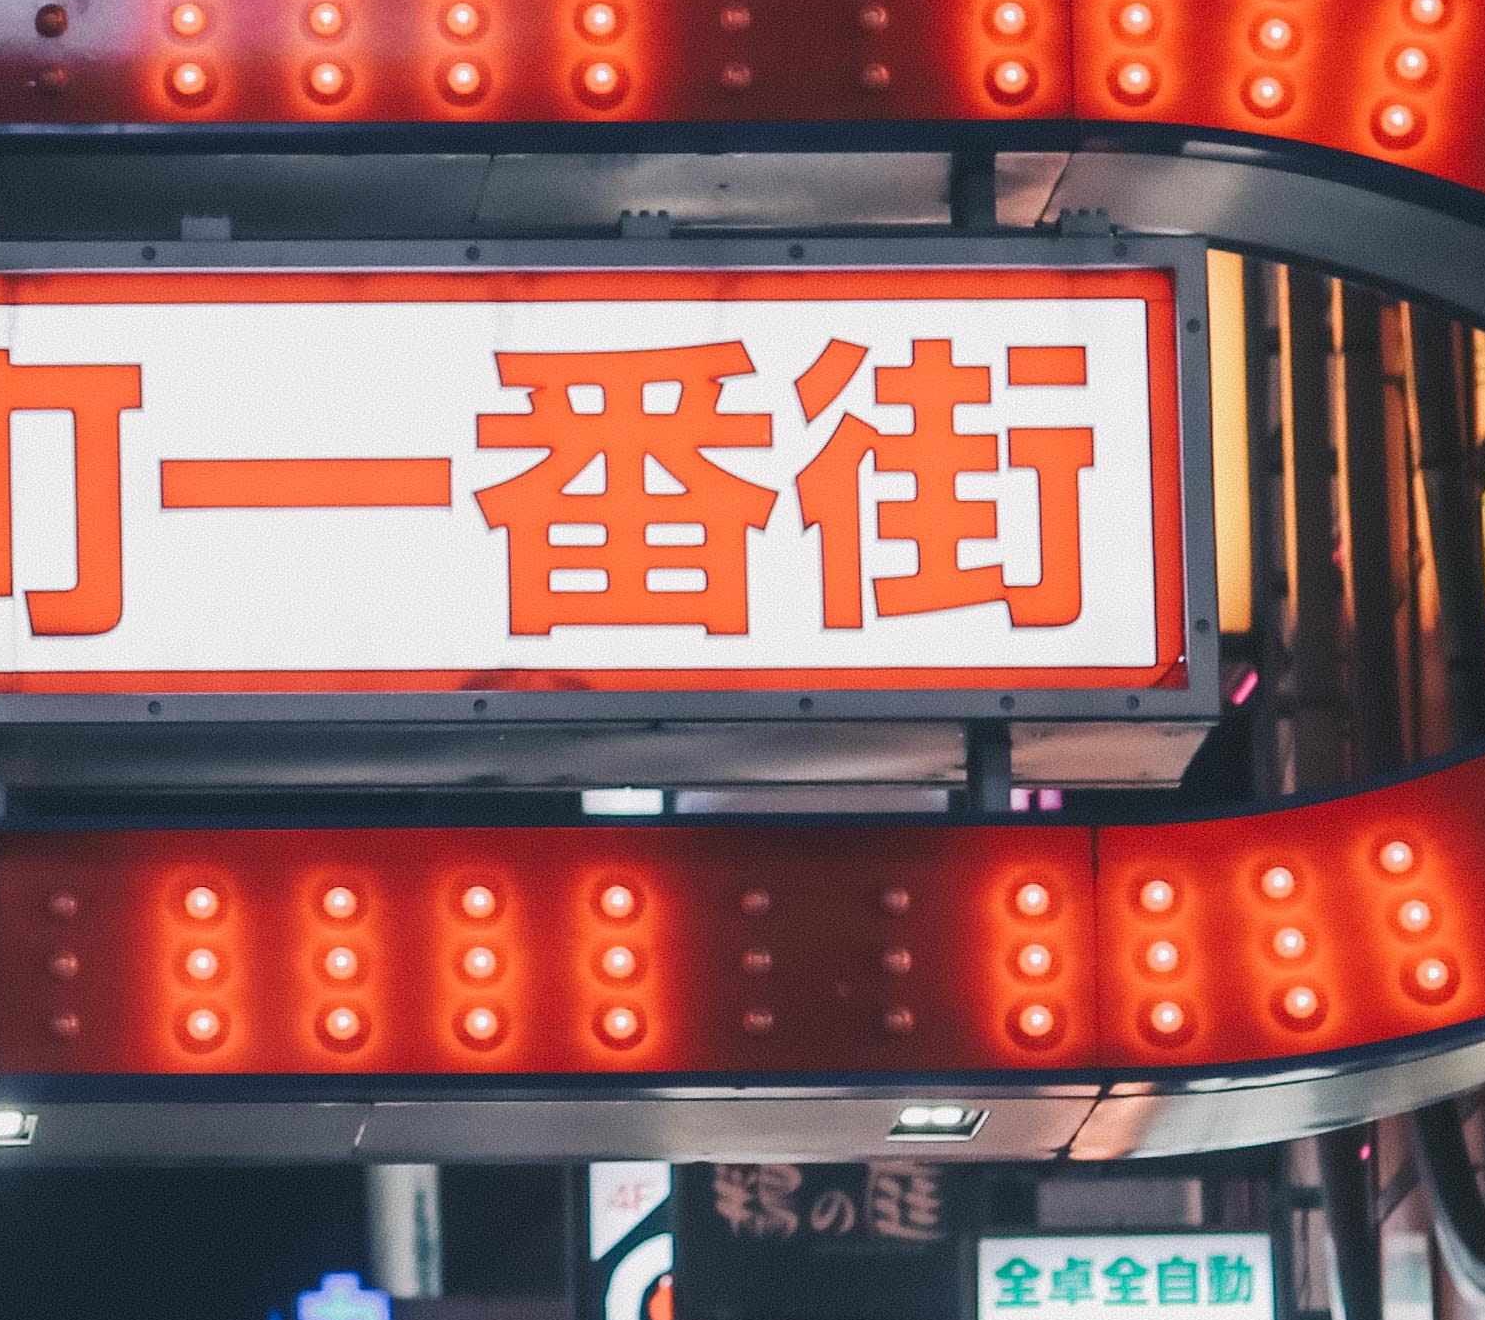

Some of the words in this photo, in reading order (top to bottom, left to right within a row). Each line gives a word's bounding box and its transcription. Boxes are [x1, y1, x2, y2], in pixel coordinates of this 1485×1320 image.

[994, 1254, 1255, 1309] 全卓全自動
